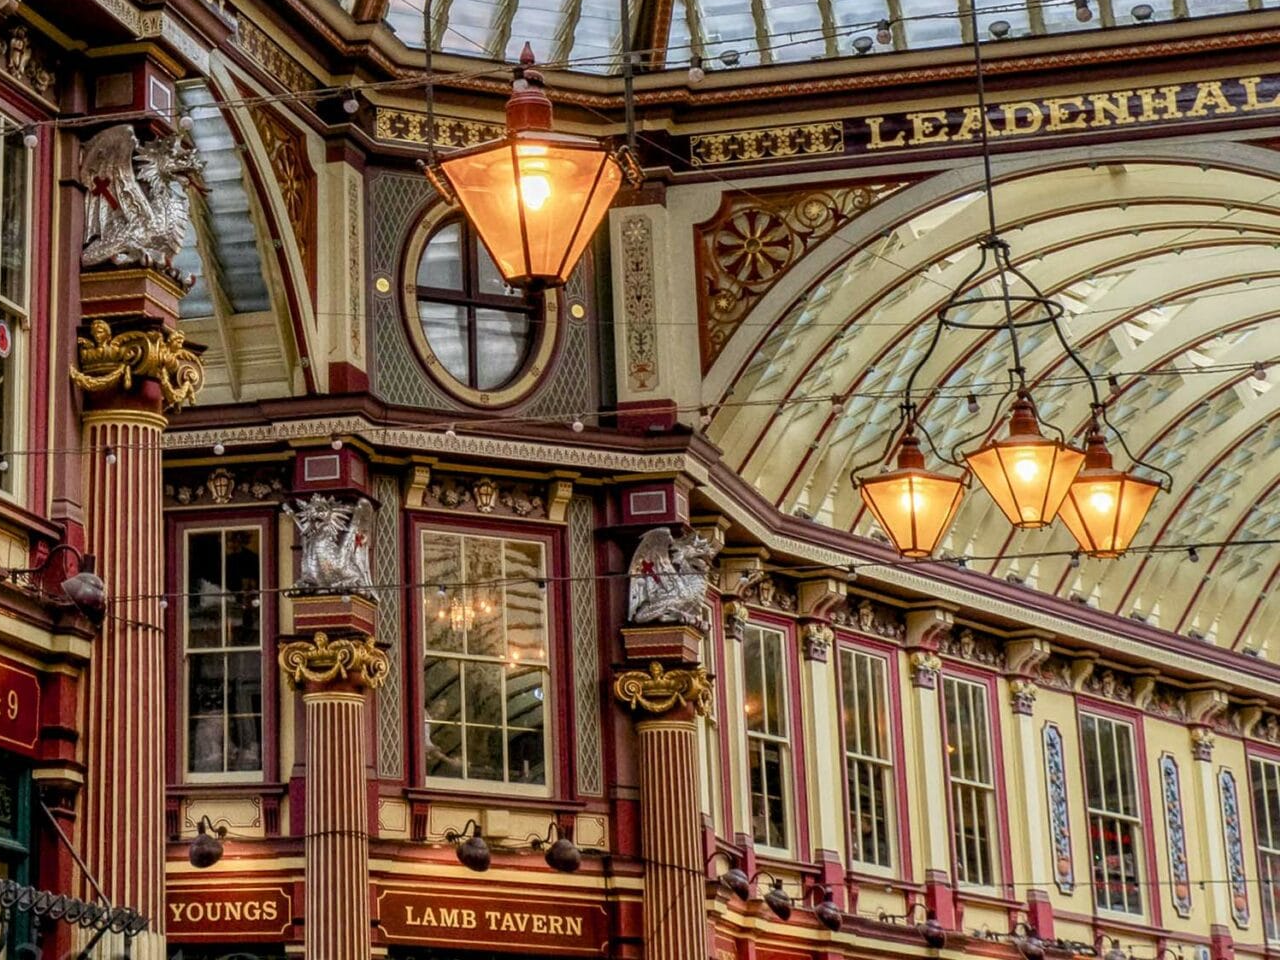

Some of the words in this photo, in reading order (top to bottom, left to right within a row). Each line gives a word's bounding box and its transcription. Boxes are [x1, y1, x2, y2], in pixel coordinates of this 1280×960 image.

[7, 689, 19, 720] 9
[169, 900, 279, 922] YOUNGS
[405, 905, 477, 928] LAMB
[486, 910, 584, 936] TAVERN
